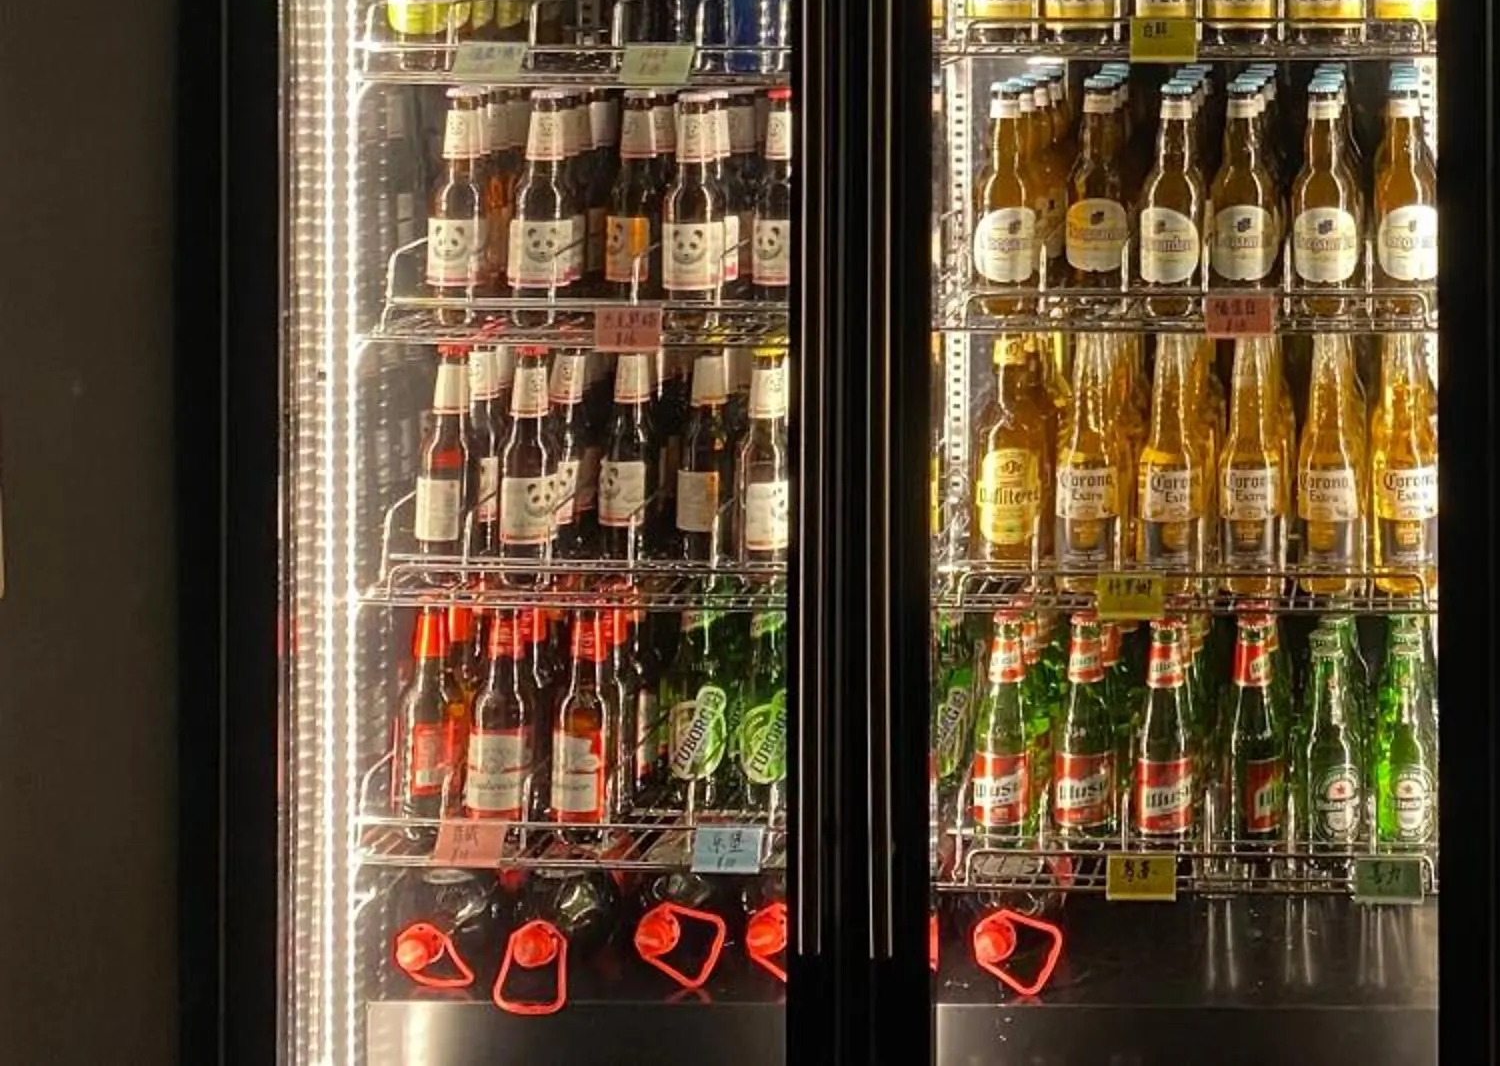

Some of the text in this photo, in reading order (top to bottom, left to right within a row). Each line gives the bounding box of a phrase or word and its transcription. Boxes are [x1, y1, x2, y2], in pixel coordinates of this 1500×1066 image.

[1059, 472, 1113, 490] Corona
[1150, 472, 1198, 492] Coro
[672, 706, 714, 771] TUBORG
